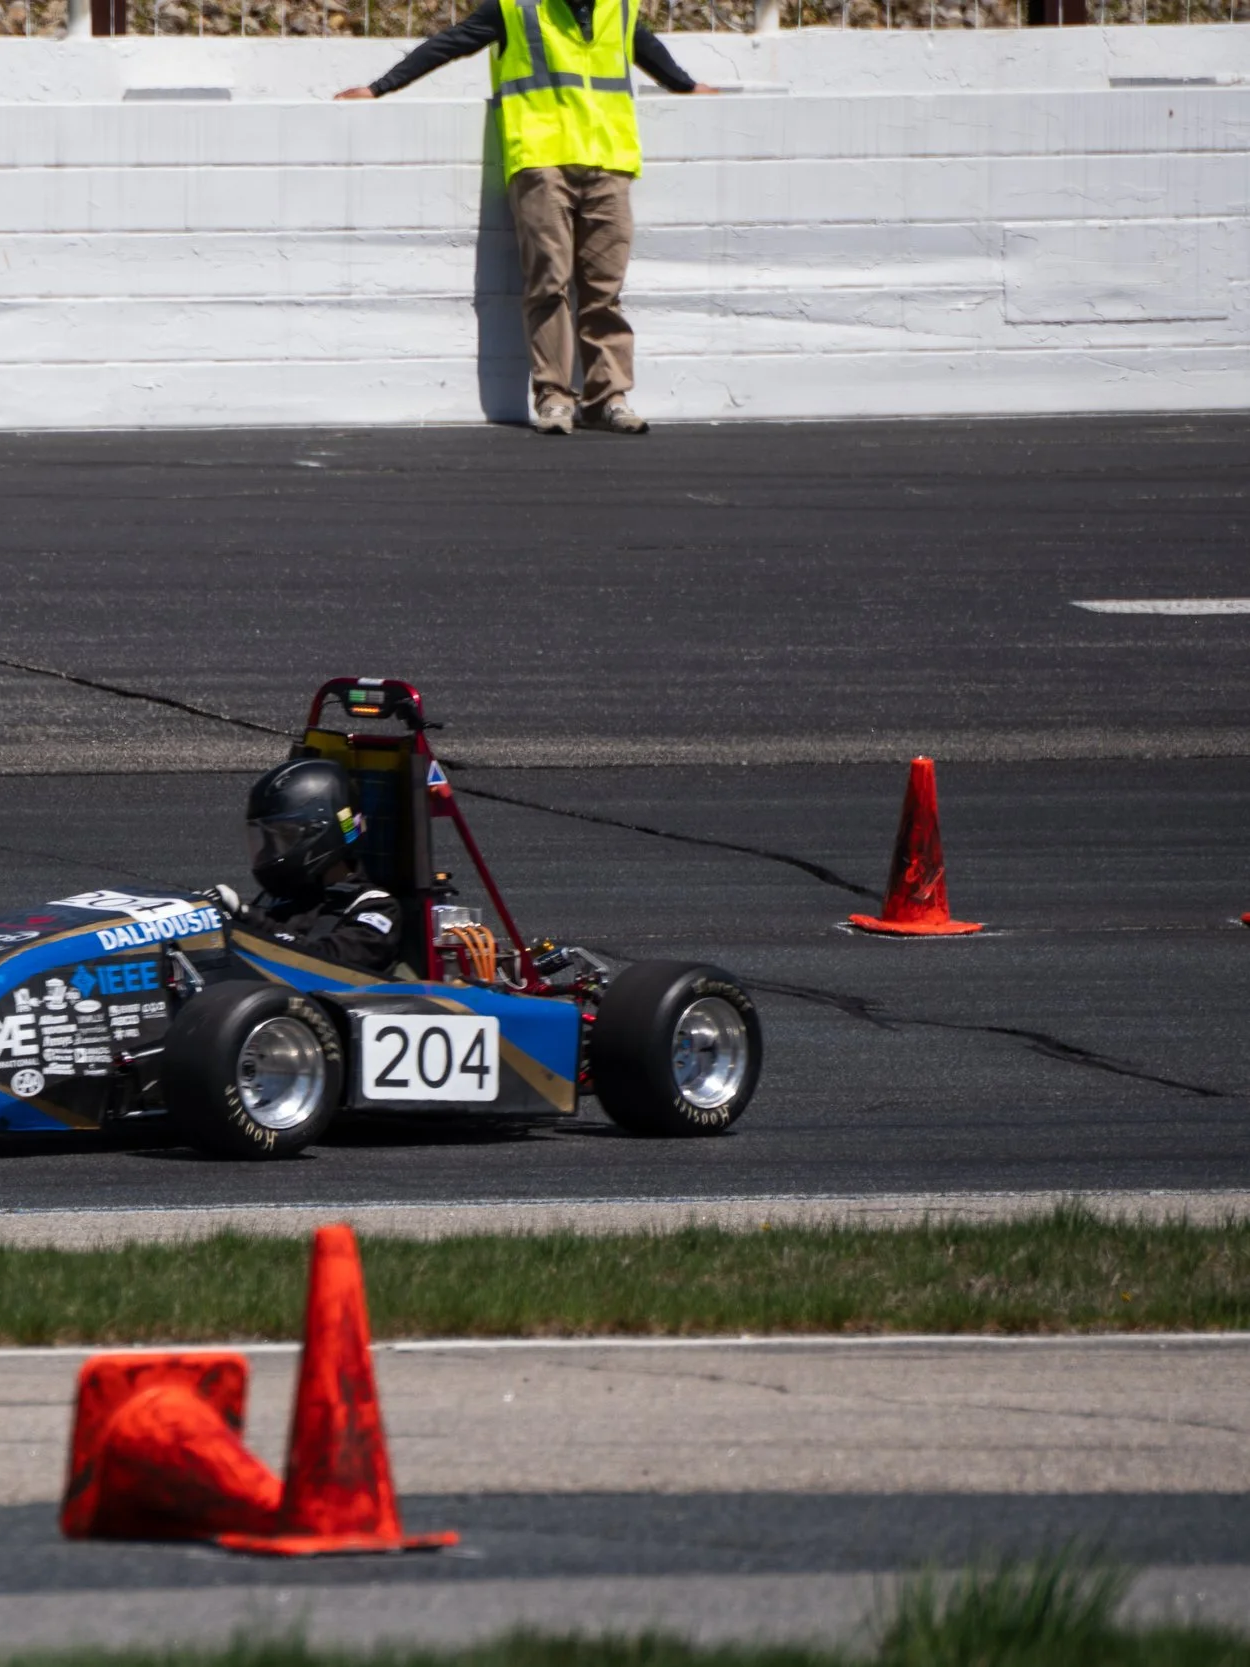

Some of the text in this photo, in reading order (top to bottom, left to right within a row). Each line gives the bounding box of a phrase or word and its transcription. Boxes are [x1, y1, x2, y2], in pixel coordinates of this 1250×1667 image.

[96, 907, 222, 950] DALHOUSIE
[95, 961, 160, 995] IEEE
[374, 1025, 490, 1090] 204
